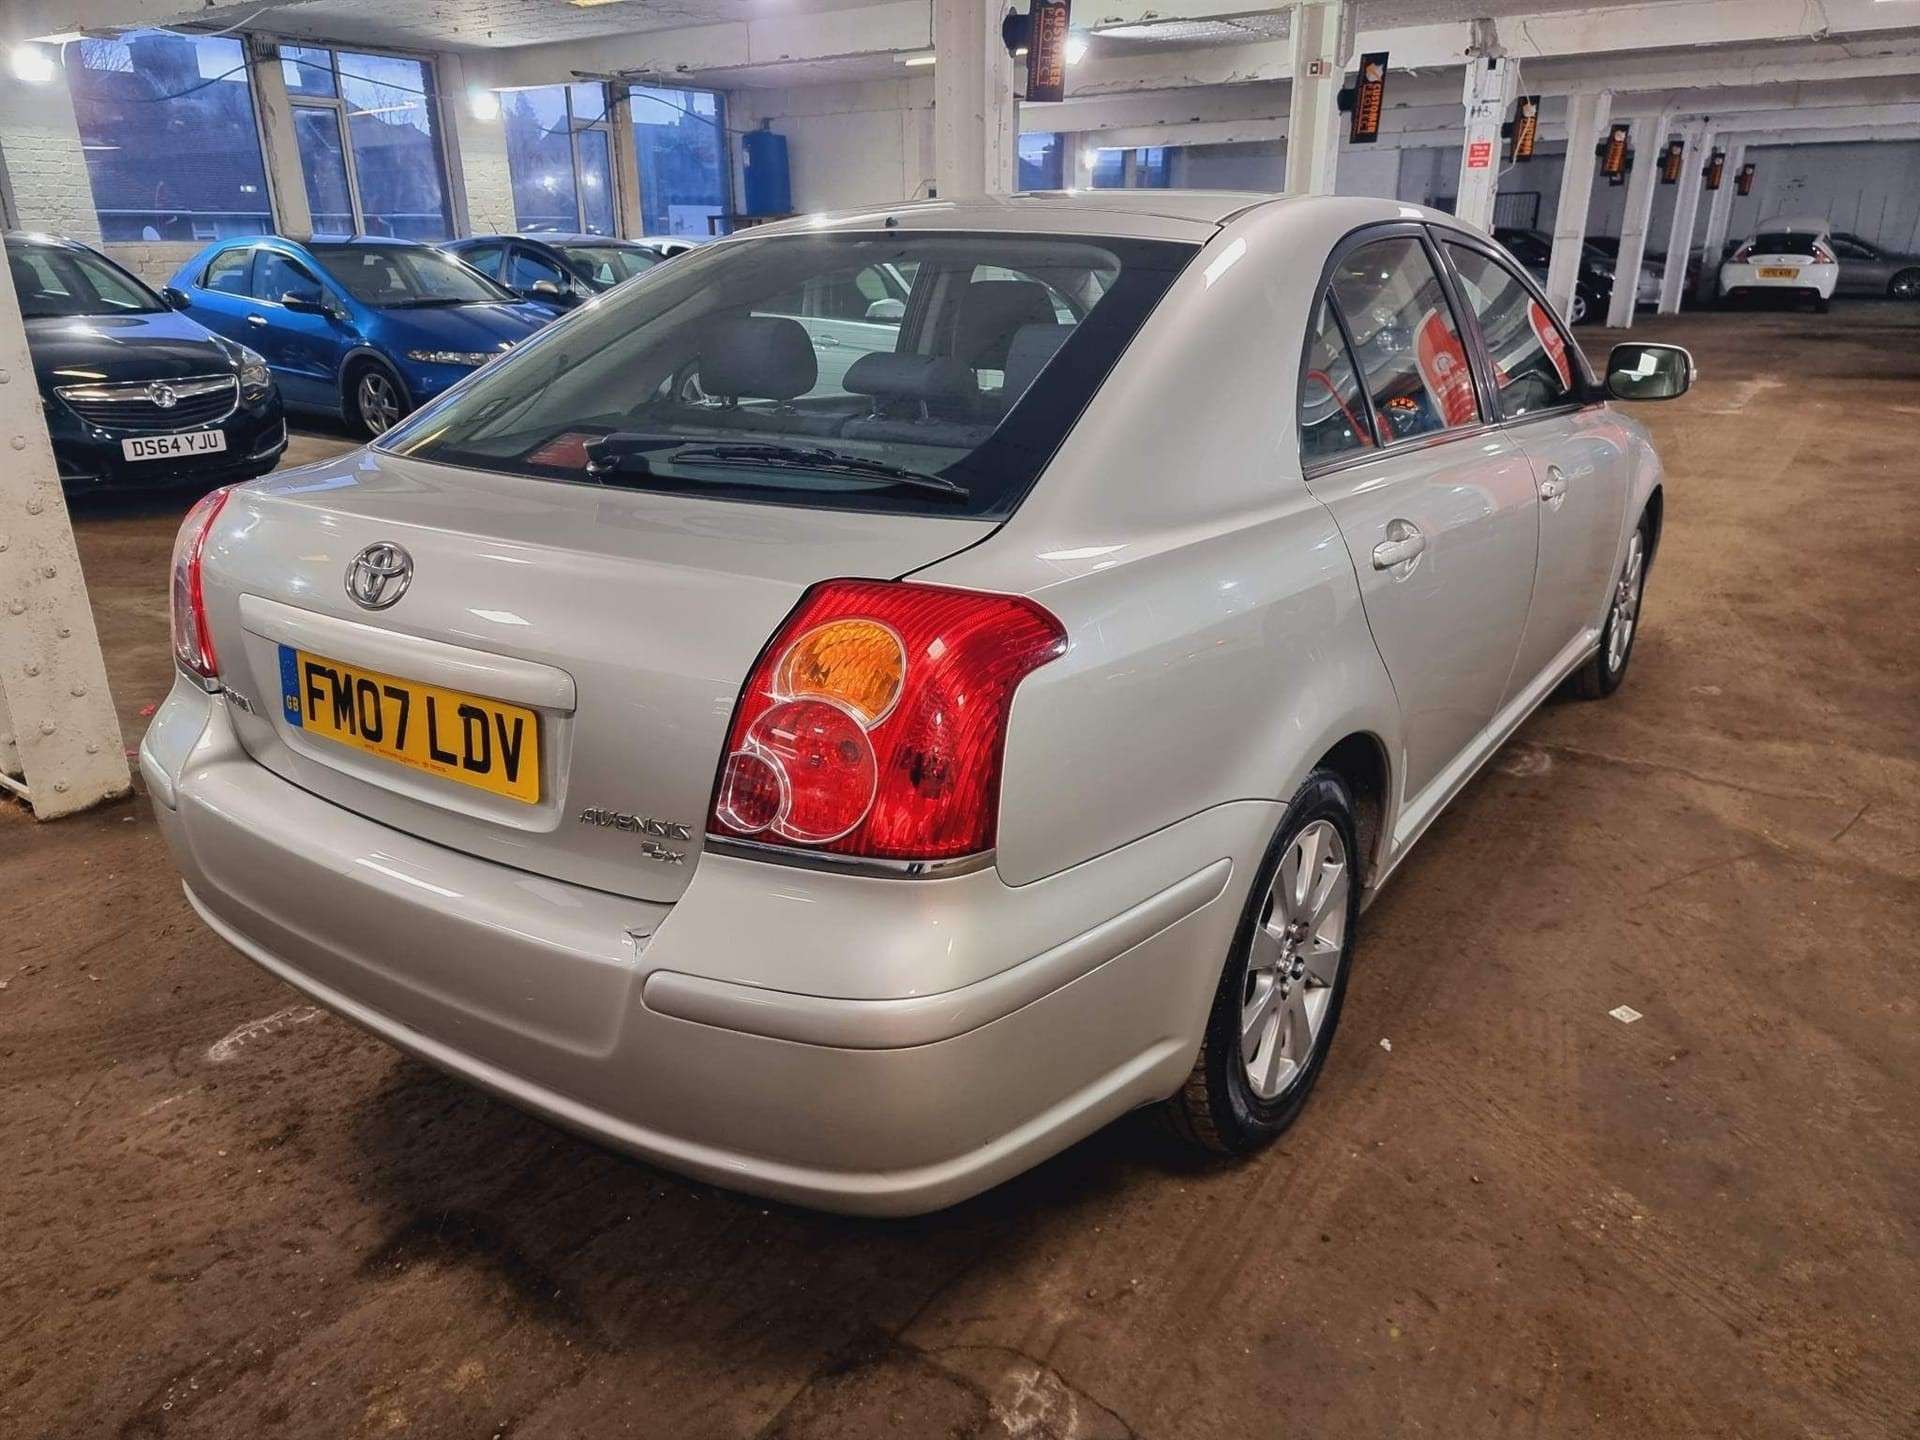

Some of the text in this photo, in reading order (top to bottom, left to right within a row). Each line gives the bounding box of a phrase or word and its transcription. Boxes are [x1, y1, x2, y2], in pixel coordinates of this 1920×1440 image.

[132, 433, 218, 457] DS64 YJU
[286, 695, 299, 712] GB
[305, 661, 524, 782] FM07 LDV
[580, 807, 692, 841] AVENSIS
